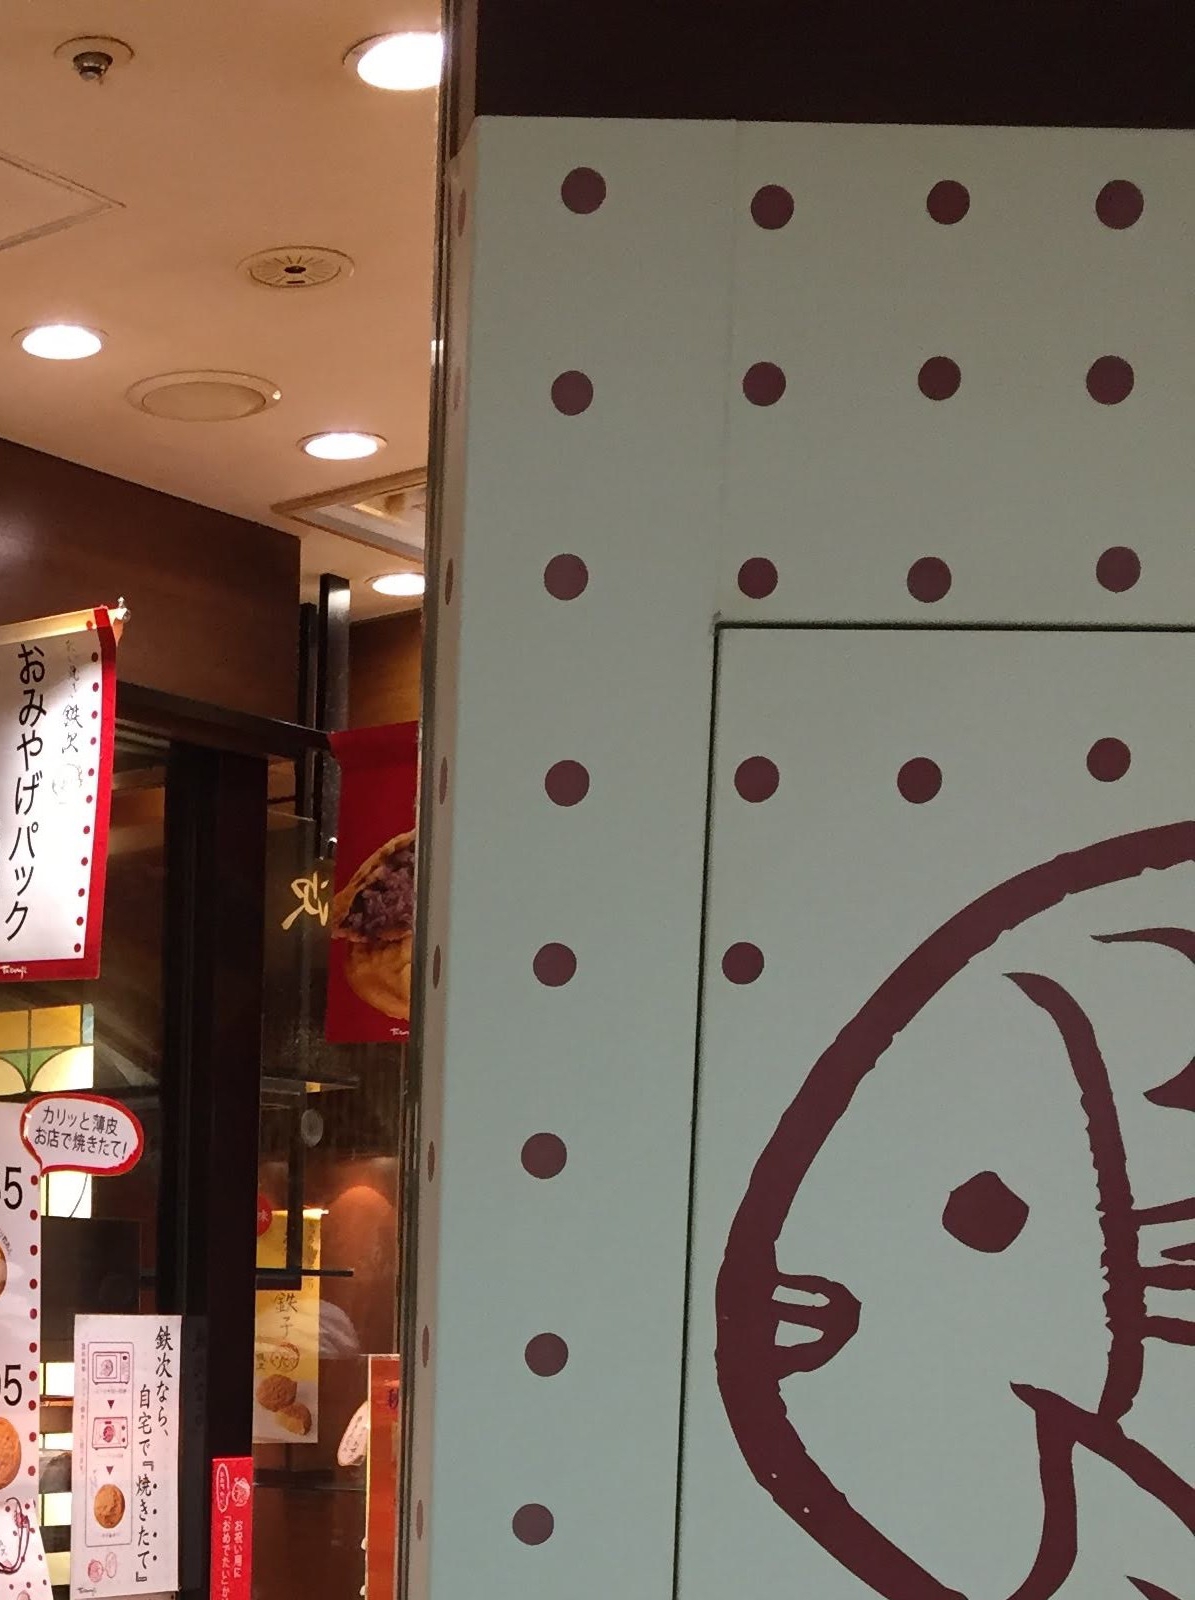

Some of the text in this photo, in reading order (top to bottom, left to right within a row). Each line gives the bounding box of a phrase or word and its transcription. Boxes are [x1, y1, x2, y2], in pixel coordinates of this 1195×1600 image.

[4, 643, 47, 942] おみやげパック
[43, 1105, 119, 1137] カリッと薄皮
[153, 1325, 174, 1437] 鉄次なら、
